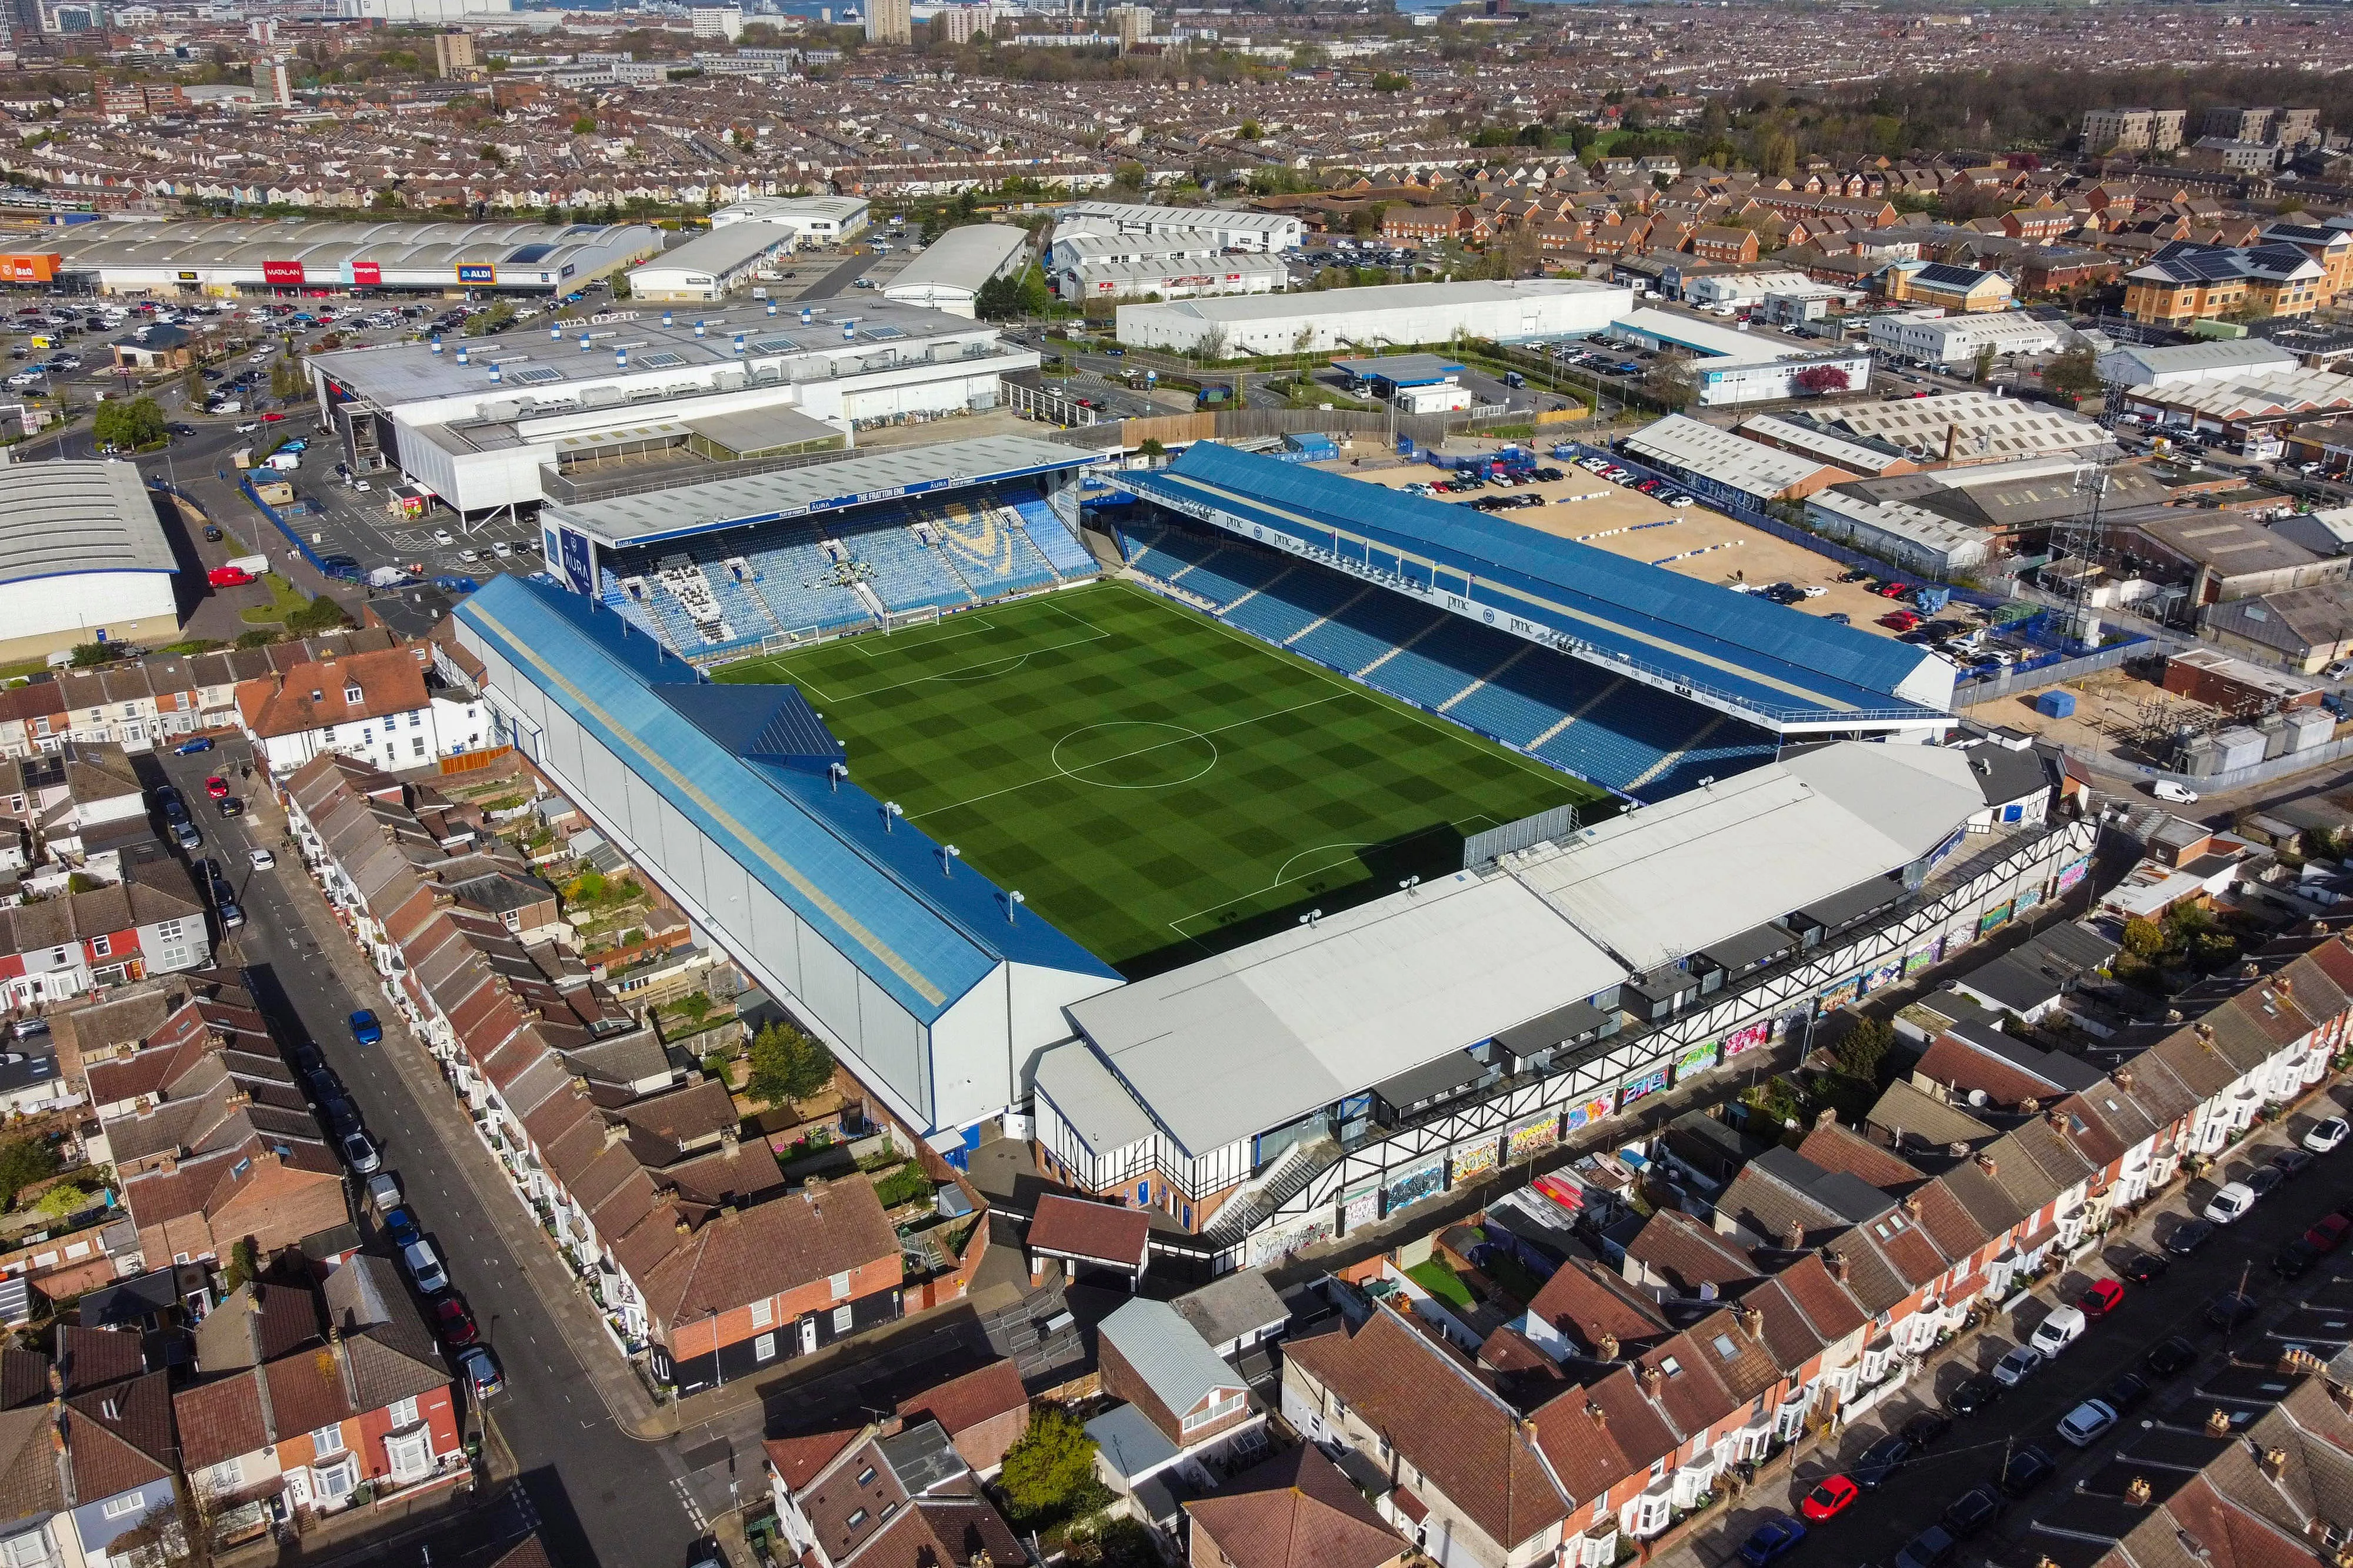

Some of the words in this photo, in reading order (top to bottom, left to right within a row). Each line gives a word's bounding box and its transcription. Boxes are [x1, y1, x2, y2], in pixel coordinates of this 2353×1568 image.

[471, 270, 491, 278] ALDI
[856, 493, 868, 502] THE
[868, 489, 893, 500] FRATTON
[894, 487, 905, 495] END
[1661, 479, 1681, 491] TOGETHER
[1697, 493, 1725, 508] PORTSMOUTH
[1227, 516, 1243, 529] pmc
[1274, 533, 1292, 546] pmc
[1448, 595, 1469, 611] pmc
[1510, 618, 1534, 634] pmc
[1651, 676, 1665, 686] pmc
[1606, 786, 1622, 797] TICKETS
[1622, 793, 1632, 801] NOW
